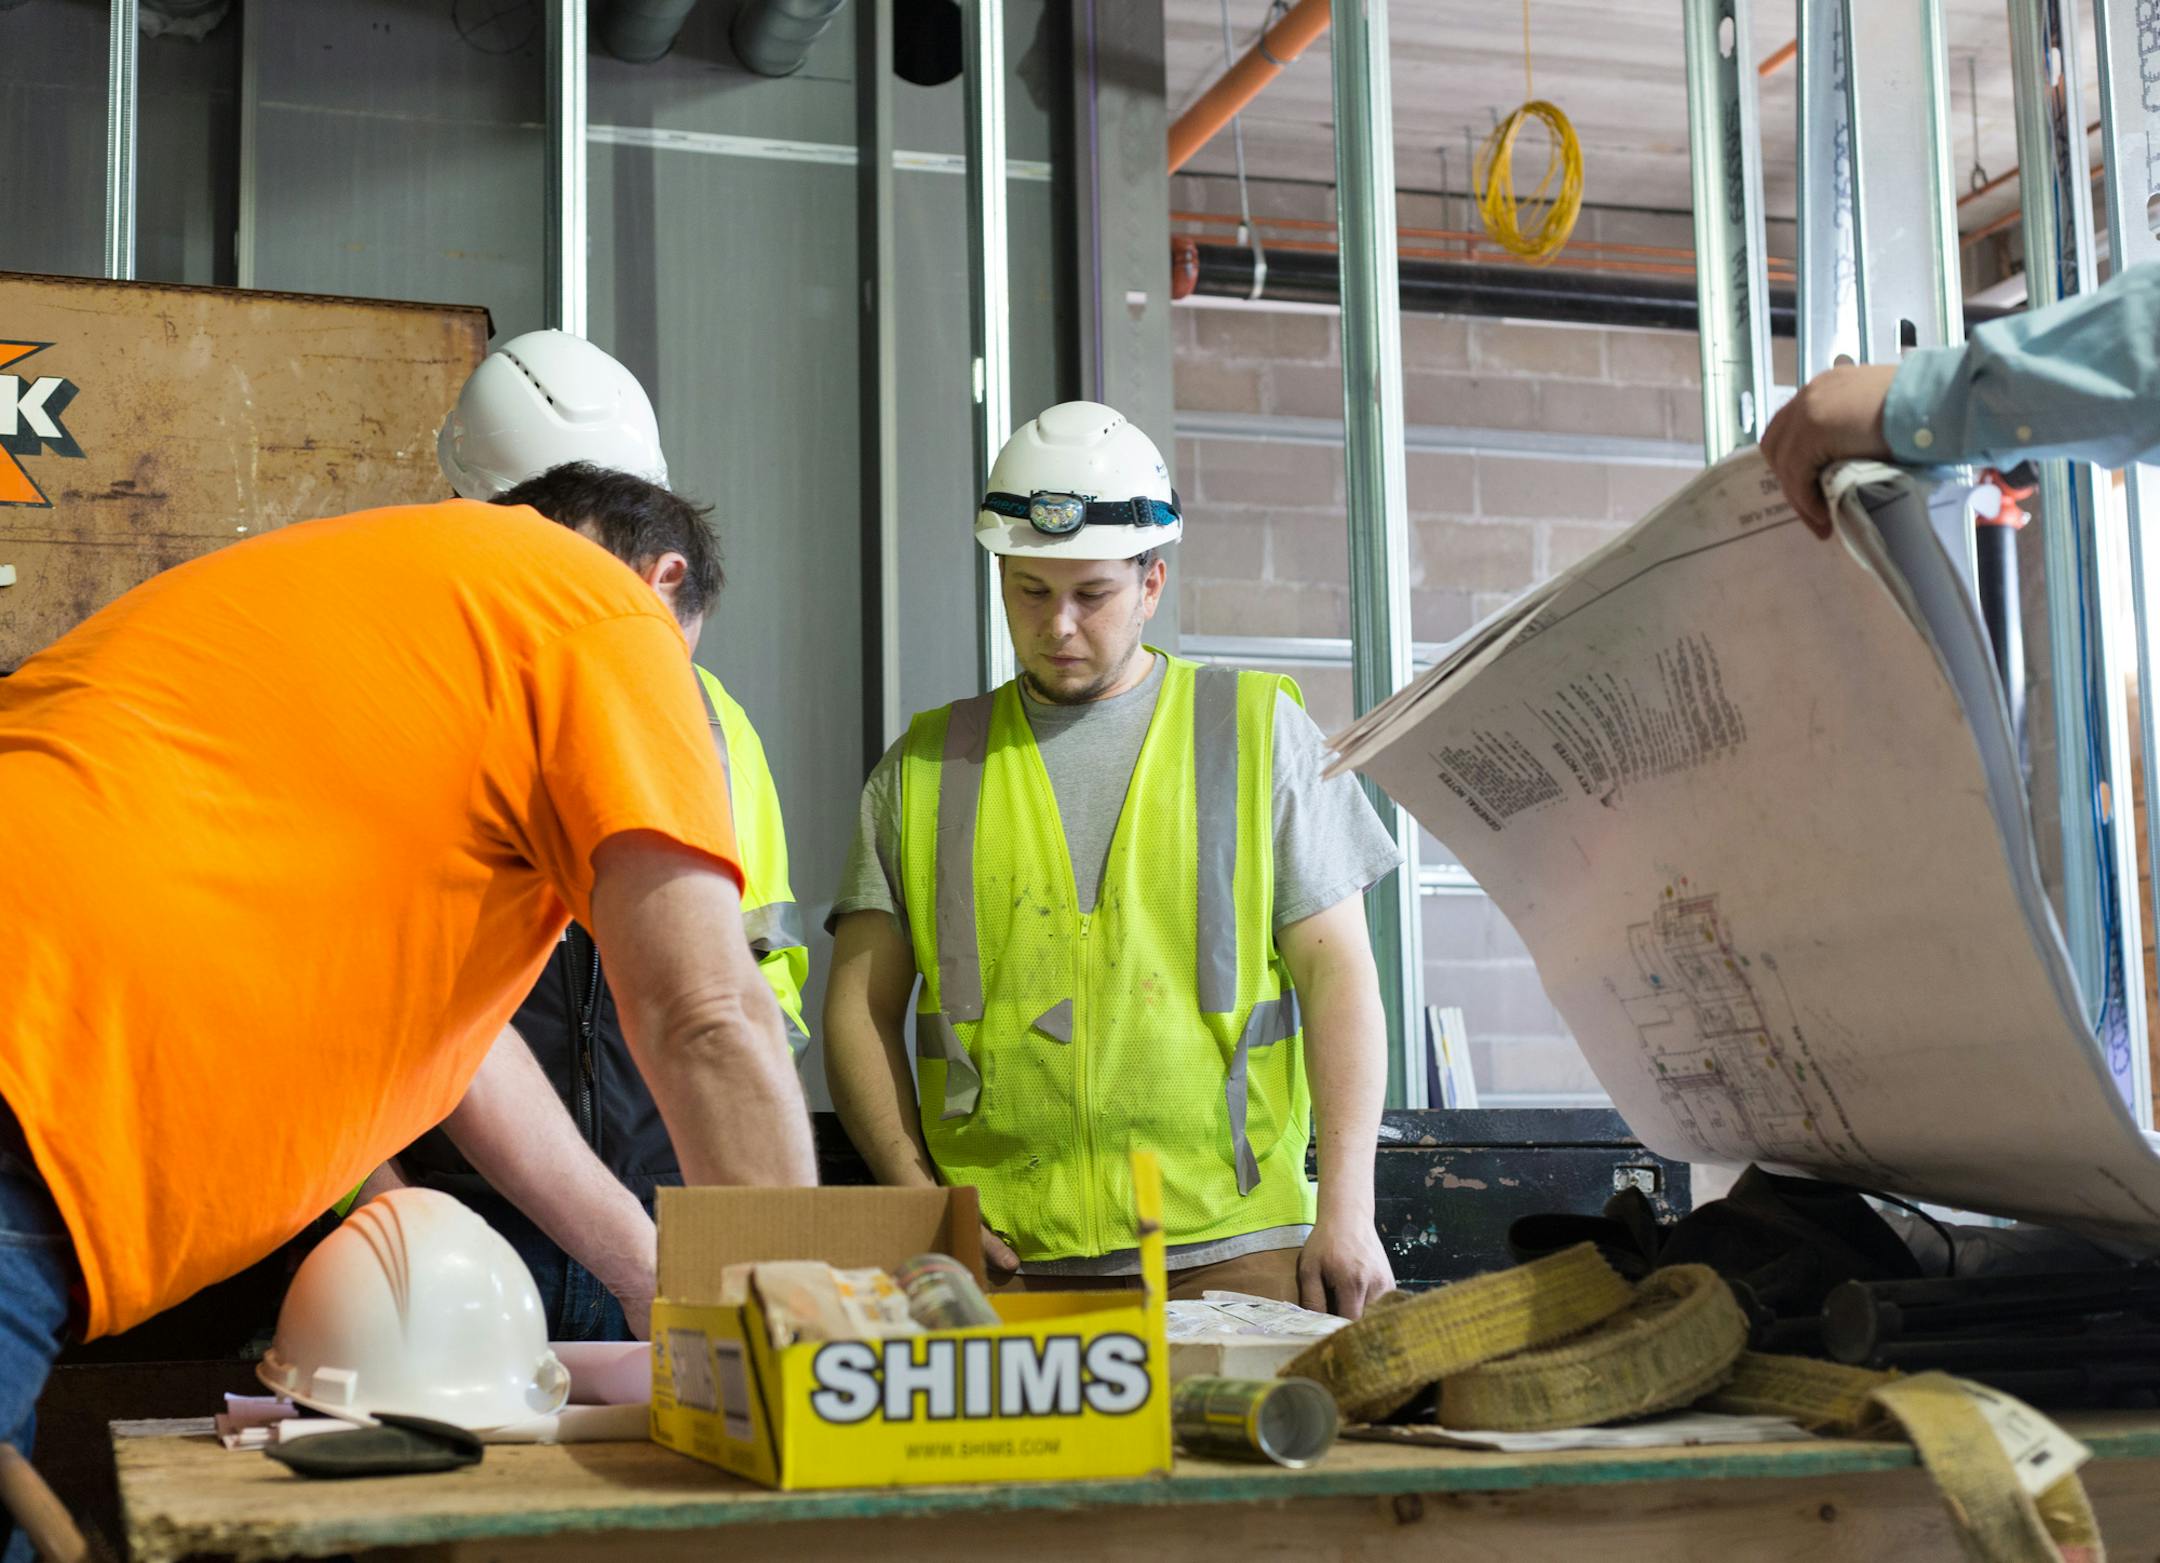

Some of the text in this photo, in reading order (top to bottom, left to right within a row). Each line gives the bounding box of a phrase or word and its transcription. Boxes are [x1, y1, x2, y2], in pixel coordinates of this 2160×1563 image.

[1552, 741, 1593, 796] KEY NOTES
[1437, 771, 1501, 832] GENERAL NOTES
[811, 1333, 1150, 1423] SHIMS
[905, 1437, 1061, 1459] WWW.SHIMS.COM
